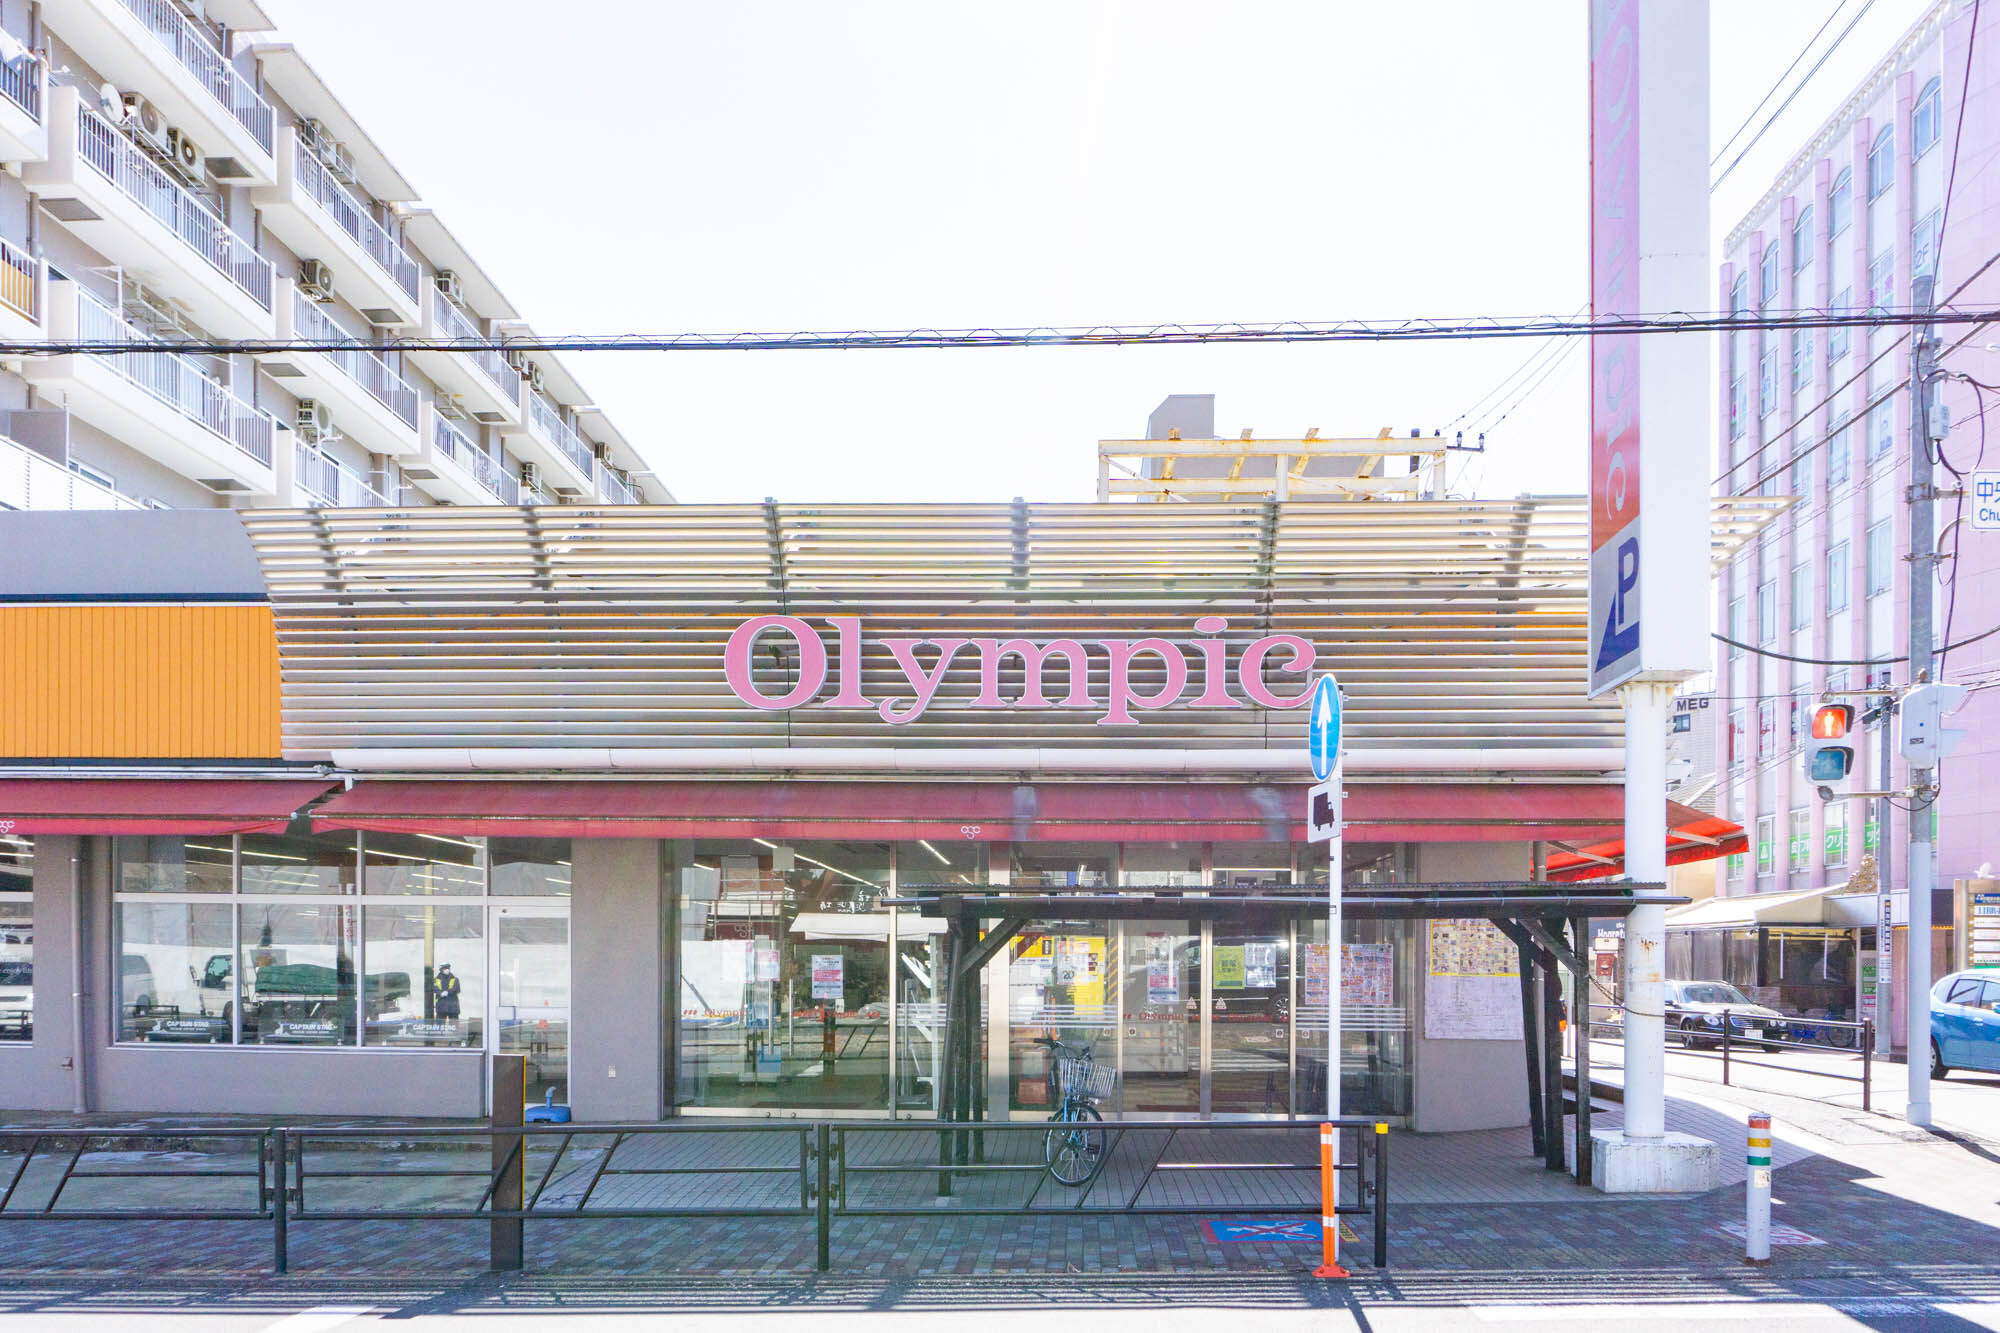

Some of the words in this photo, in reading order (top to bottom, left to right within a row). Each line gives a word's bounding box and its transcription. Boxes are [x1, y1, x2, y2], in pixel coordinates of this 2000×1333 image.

[1618, 536, 1640, 626] P
[723, 614, 1321, 726] Olympic
[1676, 697, 1709, 712] MEG
